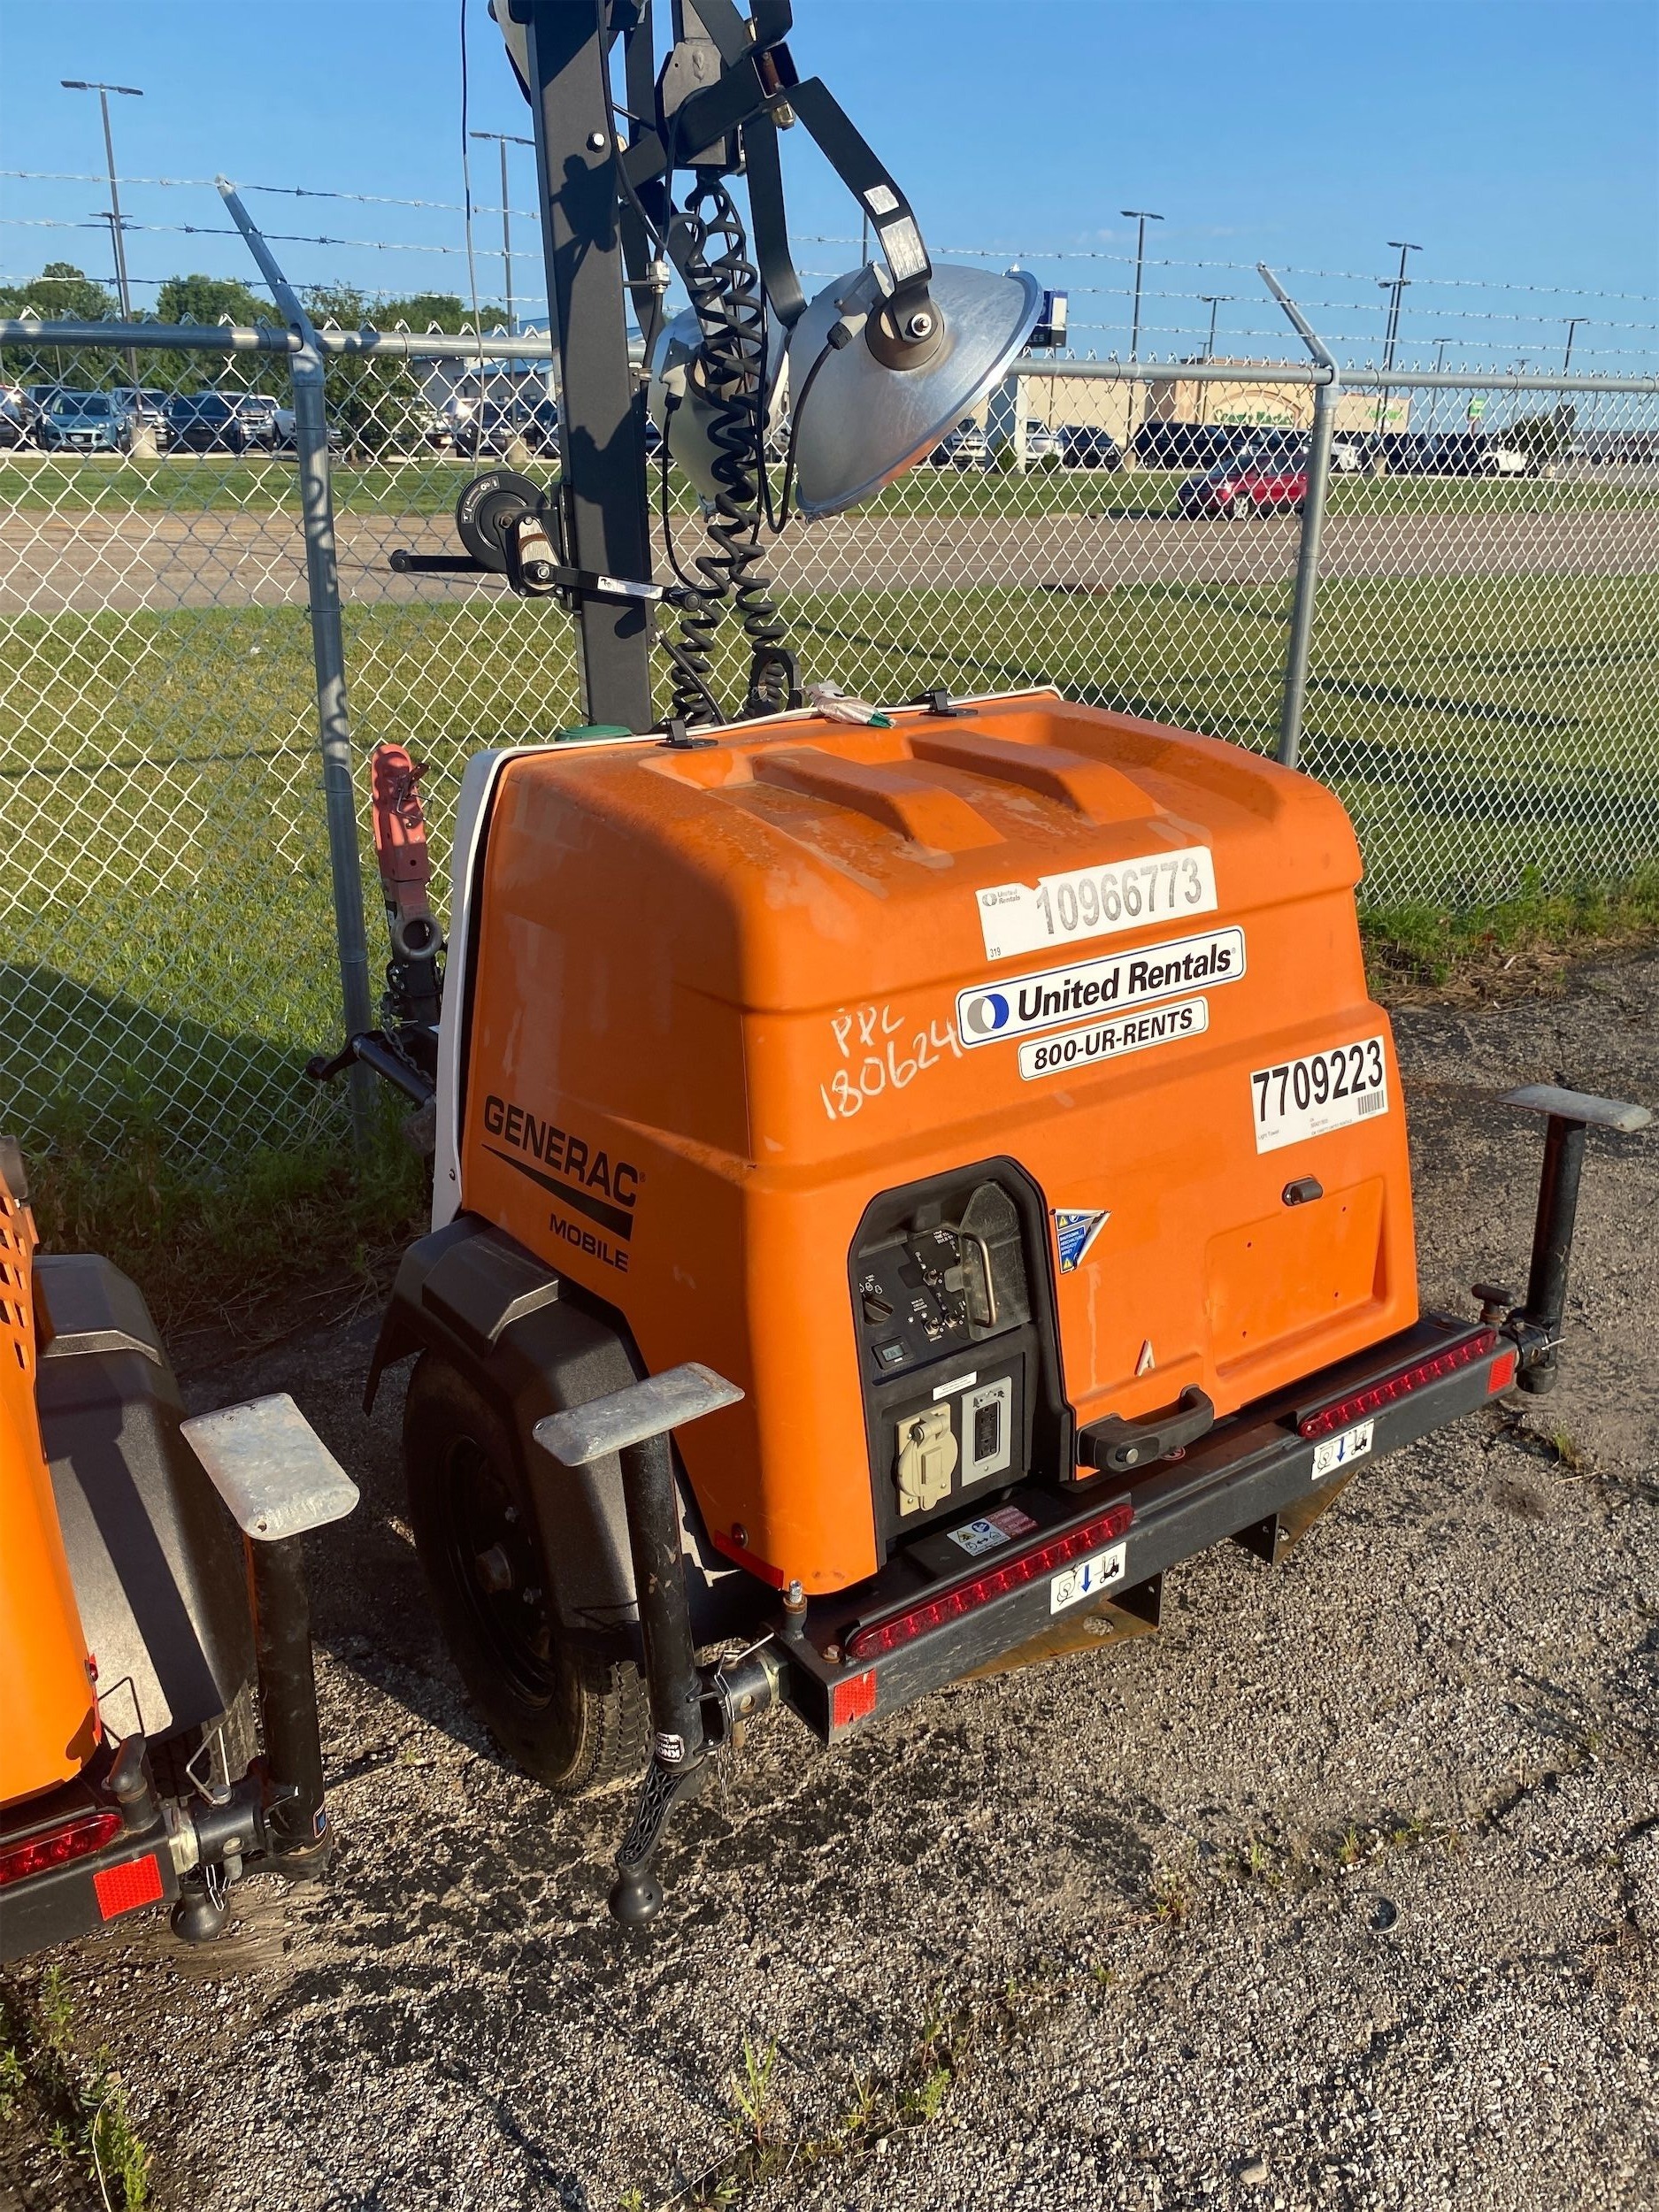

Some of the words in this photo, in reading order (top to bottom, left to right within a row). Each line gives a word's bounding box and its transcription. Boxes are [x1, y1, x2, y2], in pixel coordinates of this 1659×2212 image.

[997, 888, 1018, 898] United
[999, 895, 1020, 904] Rentals
[1035, 856, 1202, 935] 10966773
[990, 947, 1001, 957] 319
[1018, 968, 1119, 1021] United
[820, 1017, 963, 1120] 180624
[1033, 1007, 1194, 1071] 800-UR-RENTS
[1253, 1040, 1384, 1122] 7709223
[484, 1094, 638, 1208] GENERAC
[549, 1213, 629, 1273] MOBILE
[657, 1746, 680, 1759] KNO
